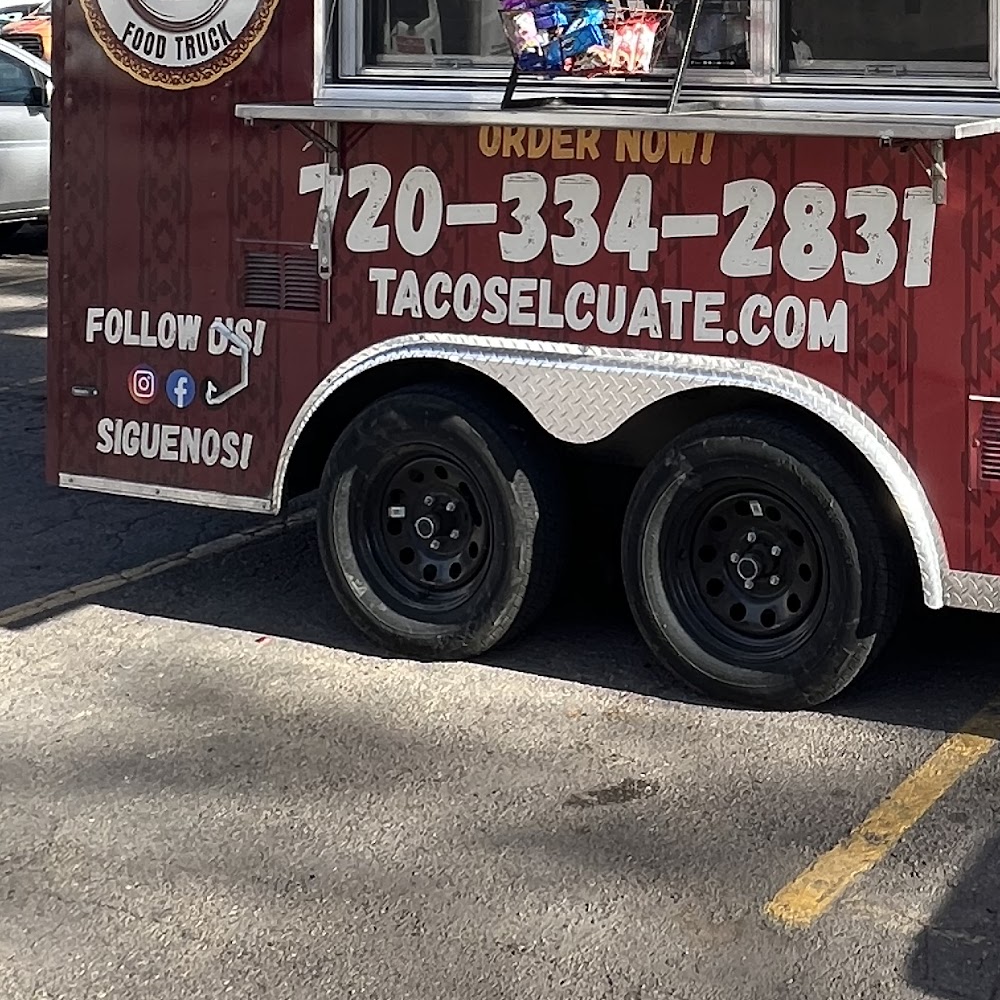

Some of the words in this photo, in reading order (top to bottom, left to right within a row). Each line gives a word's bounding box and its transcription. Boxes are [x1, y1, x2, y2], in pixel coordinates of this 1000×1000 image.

[122, 21, 167, 59] FOOD
[174, 20, 233, 60] TRUCK
[478, 126, 601, 160] ORDER
[615, 129, 717, 165] NOW!
[299, 163, 937, 288] 720-334-2831
[85, 307, 201, 351] FOLLOW
[208, 317, 266, 356] US!
[368, 268, 849, 352] TACOSELCUATE.COM
[96, 417, 252, 470] SIGUENOS!
